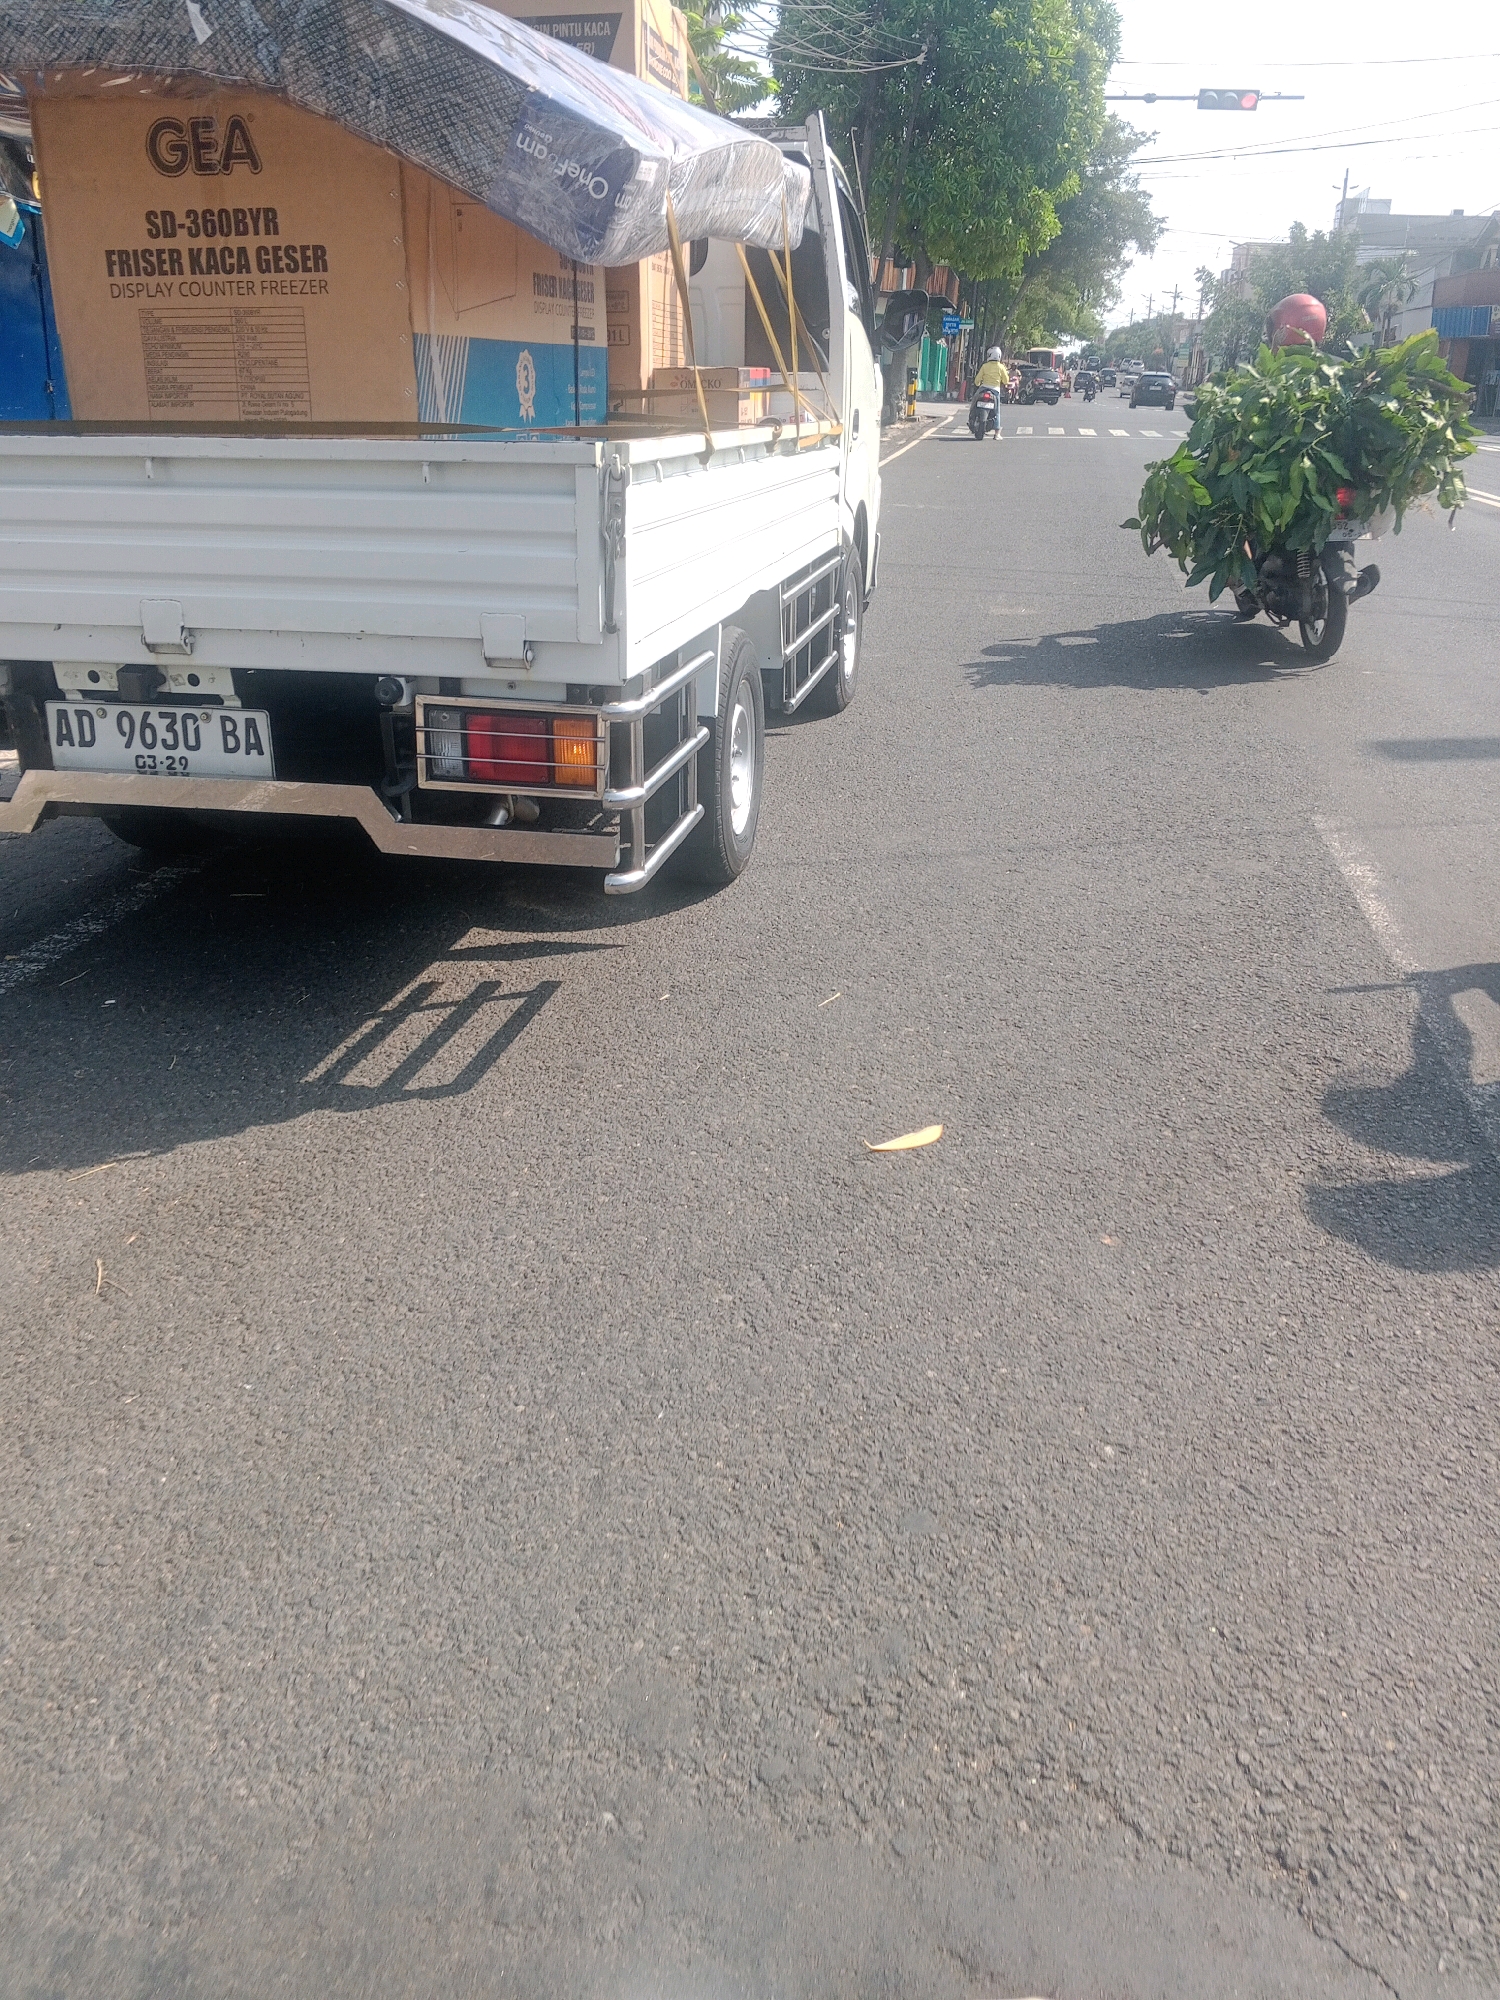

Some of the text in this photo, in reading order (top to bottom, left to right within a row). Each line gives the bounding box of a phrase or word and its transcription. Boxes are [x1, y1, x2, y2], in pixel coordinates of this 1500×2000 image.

[552, 23, 582, 38] PINTU
[584, 21, 611, 36] KACA
[145, 114, 263, 178] GEA
[145, 207, 280, 239] SD-360BYR
[105, 245, 329, 277] FRISER KACA GESER
[109, 279, 329, 299] DISPLAY COUNTER FREEZER
[532, 271, 558, 298] FRISER
[534, 300, 555, 315] DISPLAY
[523, 363, 530, 395] 3
[680, 379, 722, 389] OMCKO
[55, 708, 265, 757] AD 9630 BA
